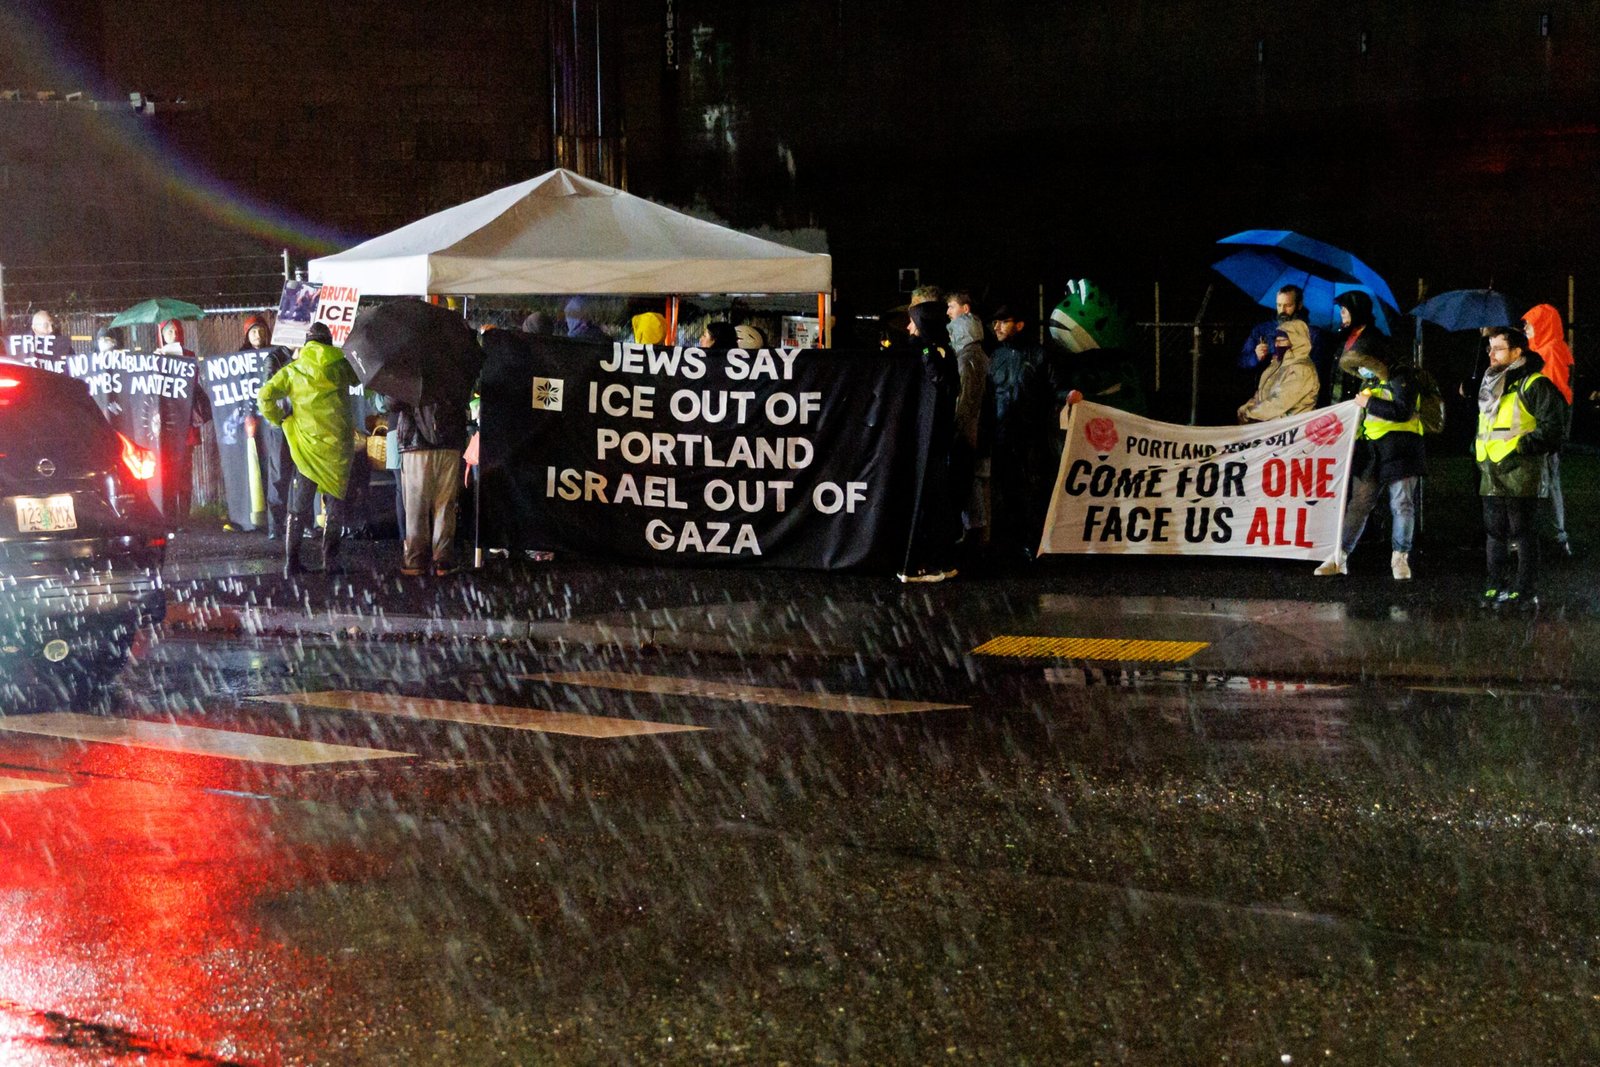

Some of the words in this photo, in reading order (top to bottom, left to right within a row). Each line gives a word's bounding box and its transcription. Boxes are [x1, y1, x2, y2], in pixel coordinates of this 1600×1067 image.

[320, 285, 358, 302] BRUTAL
[318, 305, 354, 322] ICE
[10, 335, 56, 356] FREE
[600, 342, 707, 380] JEWS
[725, 348, 802, 380] SAY
[69, 354, 88, 377] NO
[92, 350, 130, 374] MORE
[126, 354, 159, 373] BLACK
[161, 357, 195, 377] LIVES
[207, 357, 229, 381] NO
[228, 352, 258, 376] ONE
[212, 377, 266, 407] ILLEG
[589, 381, 656, 419] ICE
[669, 390, 755, 424] OUT
[764, 391, 821, 426] OF
[596, 428, 814, 470] PORTLAND
[1126, 435, 1217, 460] PORTLAND
[1265, 427, 1299, 448] SAY
[546, 466, 688, 510] ISRAEL
[703, 478, 793, 513] OUT
[812, 481, 868, 514] OF
[1065, 458, 1167, 499] COME
[1176, 461, 1248, 499] FOR
[1261, 457, 1337, 499] ONE
[644, 518, 762, 556] GAZA
[1082, 505, 1172, 543] FACE
[1184, 505, 1235, 544] US
[1246, 506, 1314, 549] ALL
